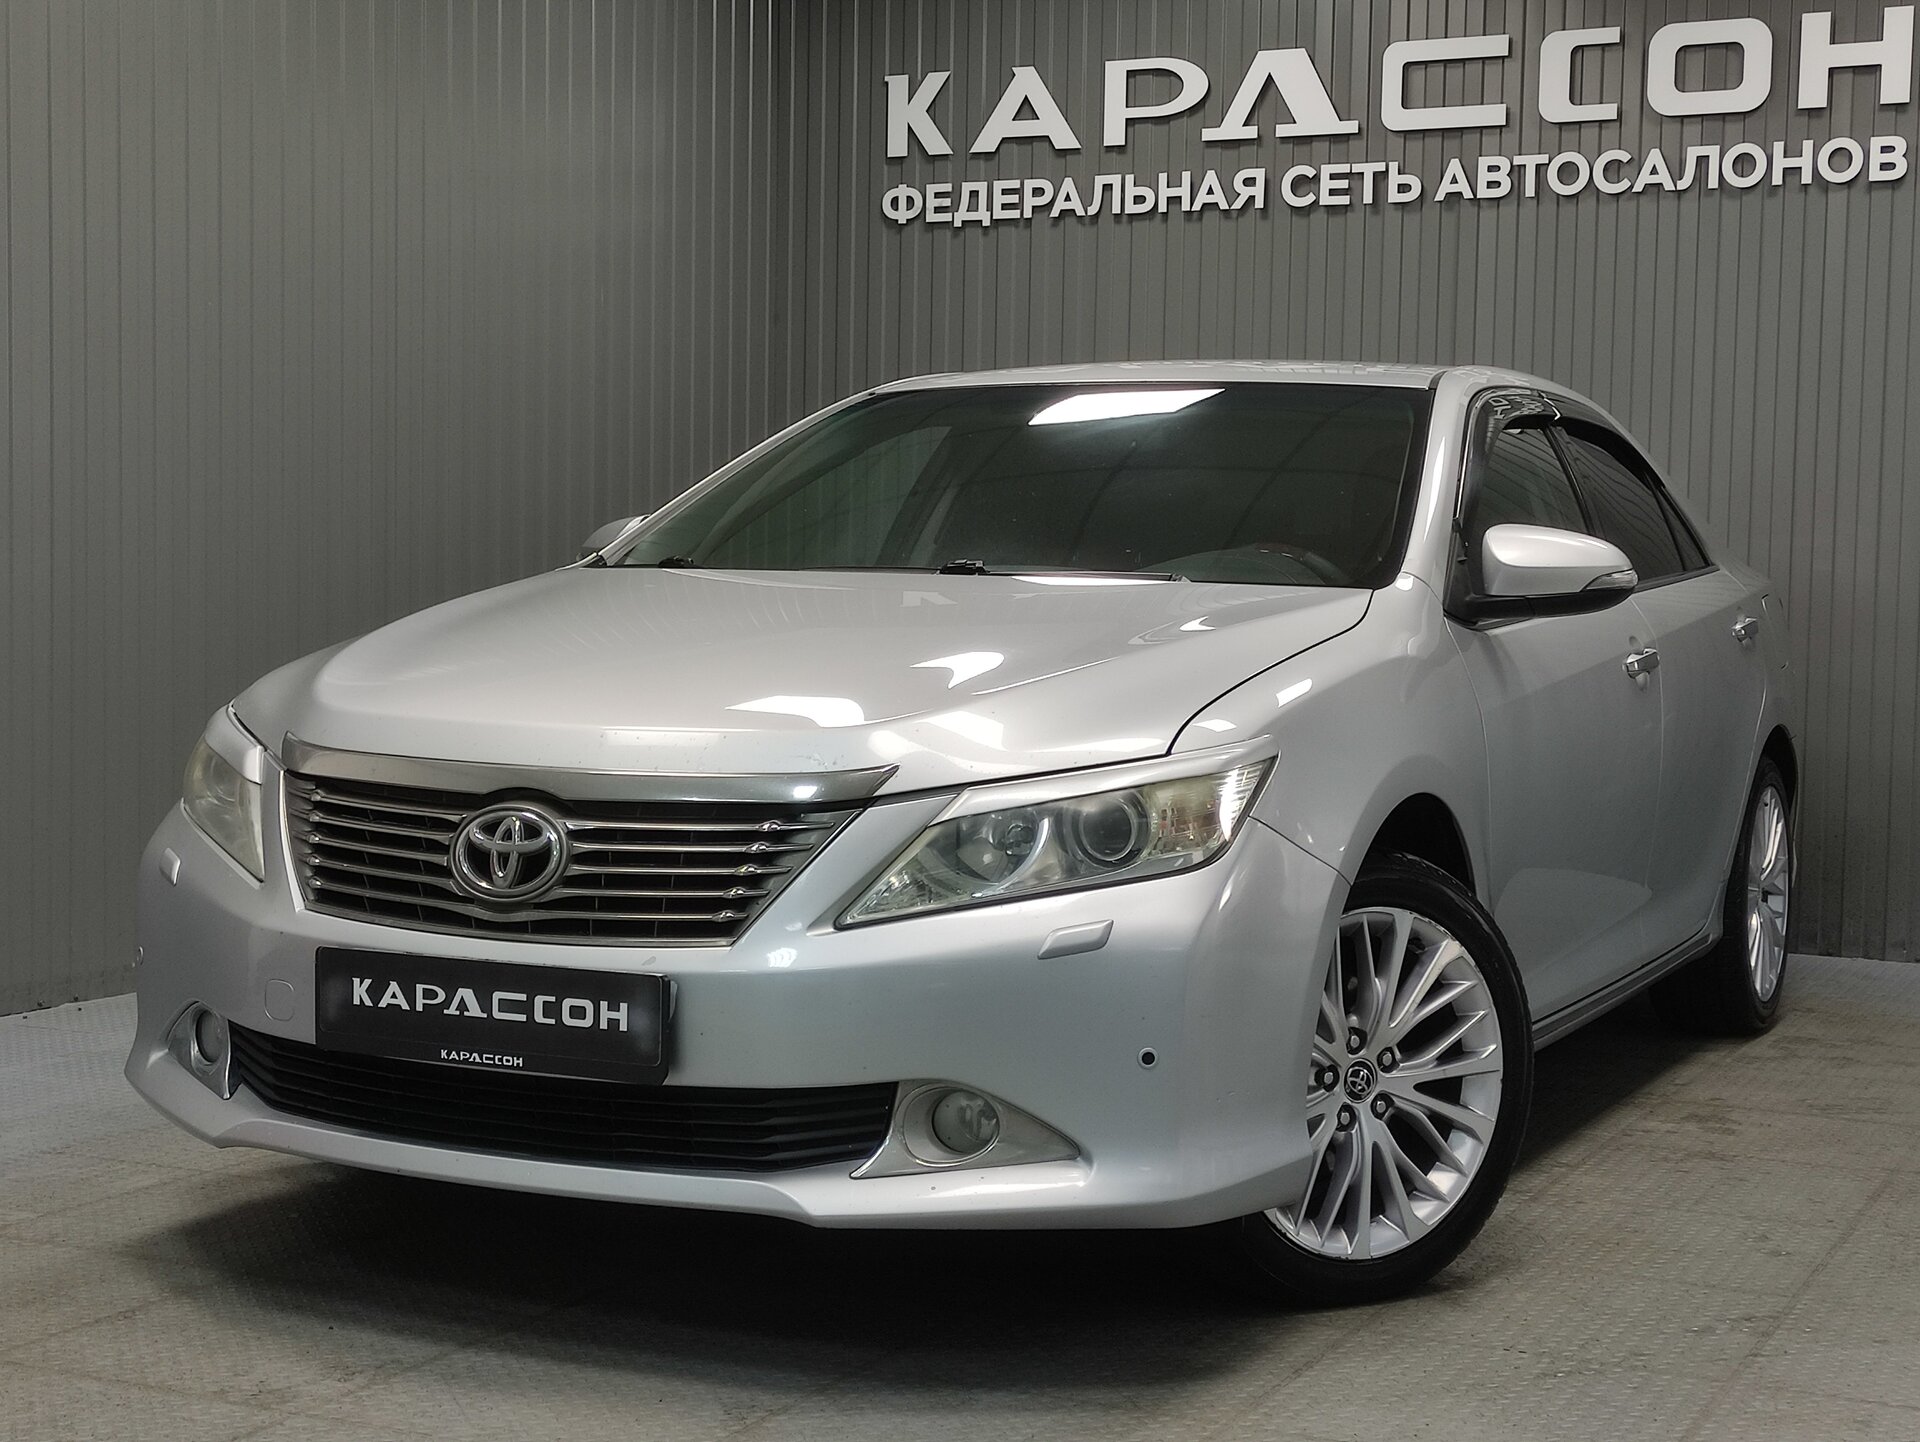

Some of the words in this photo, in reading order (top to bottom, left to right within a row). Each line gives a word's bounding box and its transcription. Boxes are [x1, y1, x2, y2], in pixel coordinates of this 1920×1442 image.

[881, 167, 1266, 228] ФЕДЕРАЛЬНАЯ
[1280, 161, 1422, 207] СЕТЬ
[1434, 135, 1909, 201] АВТОСАЛОНОВ
